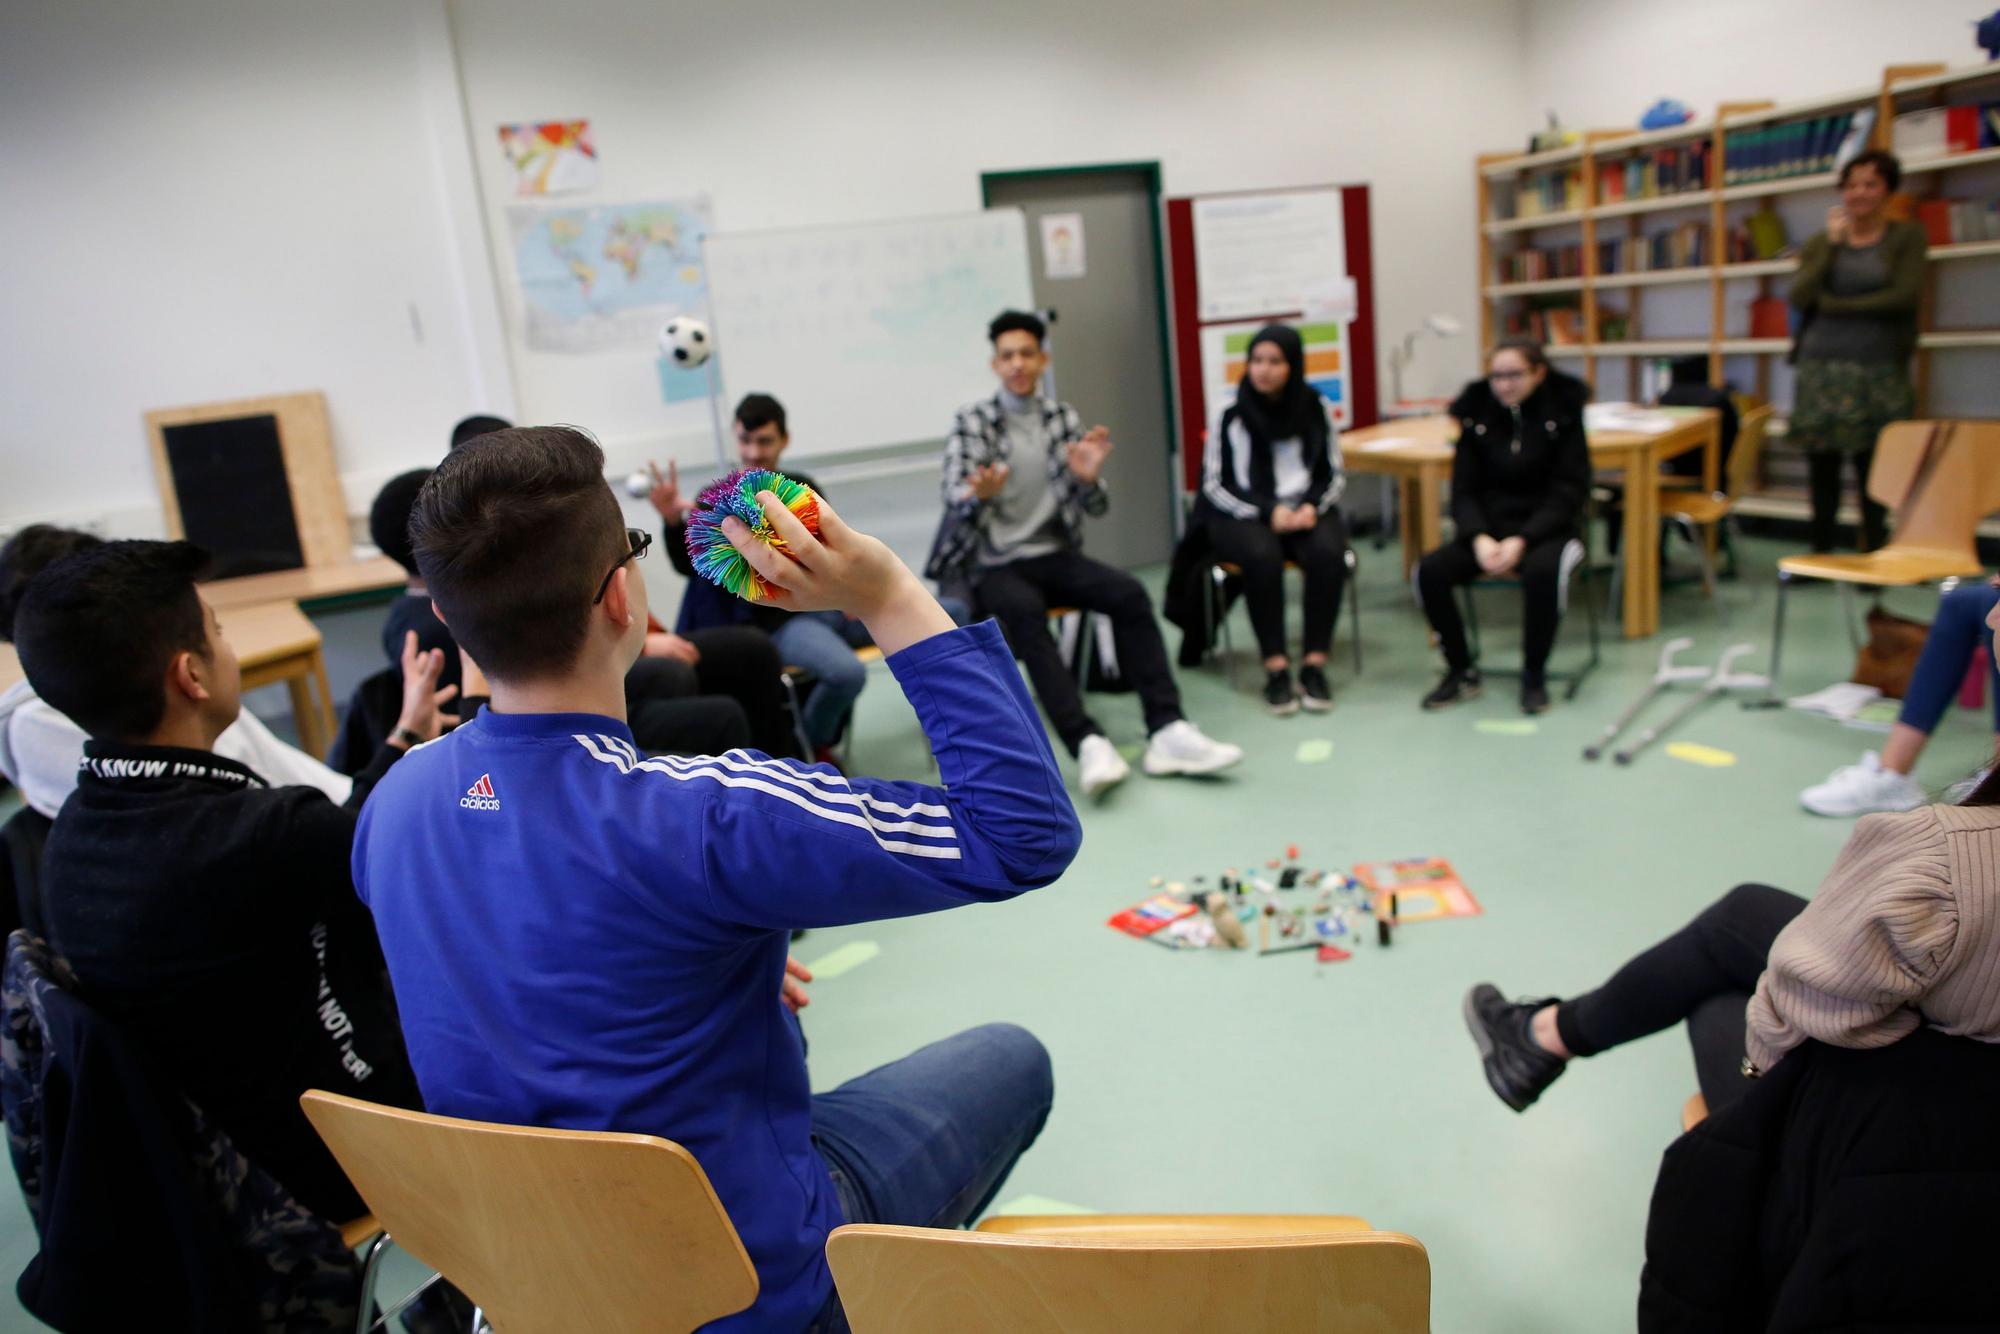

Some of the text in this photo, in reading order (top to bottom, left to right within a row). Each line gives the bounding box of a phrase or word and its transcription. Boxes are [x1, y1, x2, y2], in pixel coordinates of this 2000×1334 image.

[99, 757, 168, 778] KNOW
[460, 795, 500, 811] adidas
[317, 997, 354, 1040] NOT
